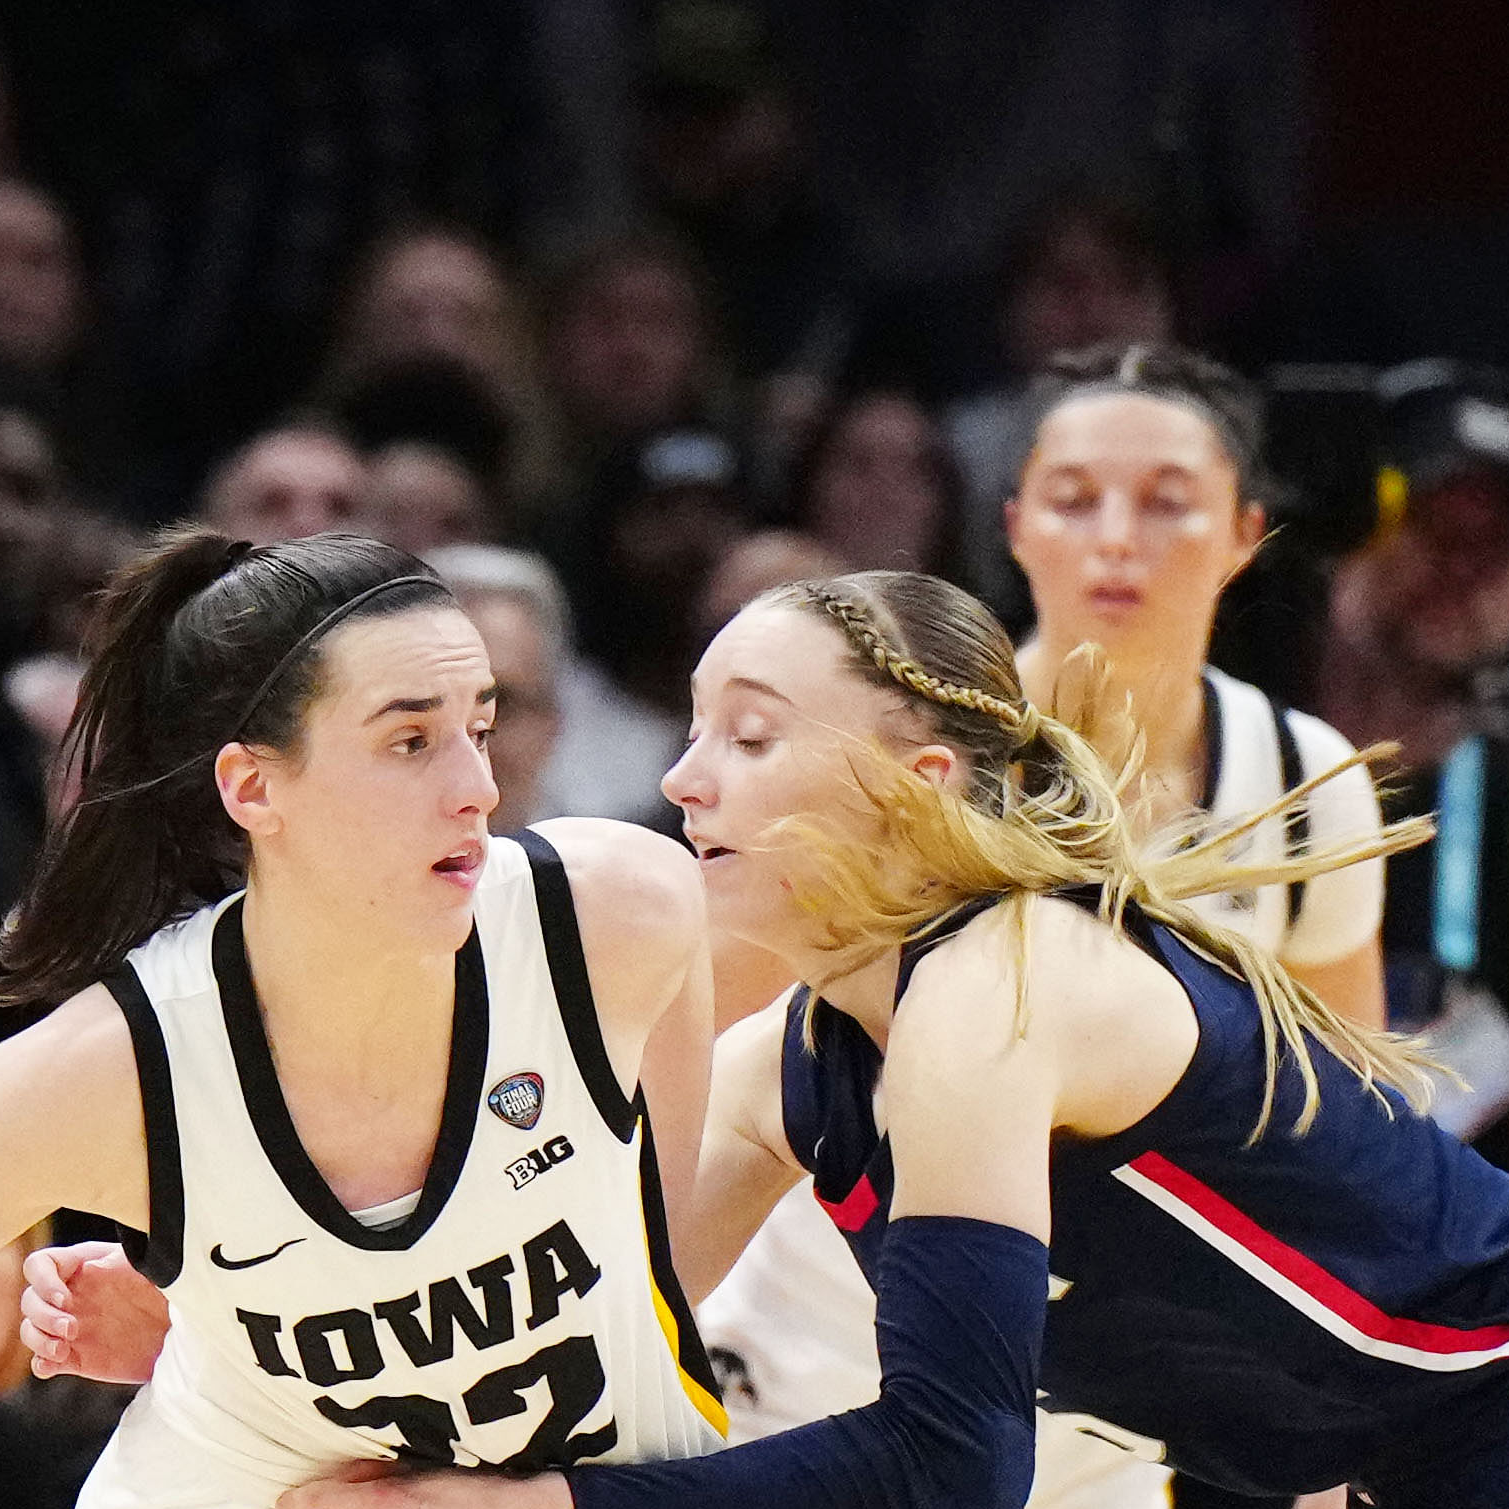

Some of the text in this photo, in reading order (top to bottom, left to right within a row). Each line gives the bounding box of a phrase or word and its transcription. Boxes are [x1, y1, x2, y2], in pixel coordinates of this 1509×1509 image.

[499, 1082, 535, 1105] FINAL
[505, 1094, 539, 1116] FOUR
[236, 1219, 602, 1388] IOWA
